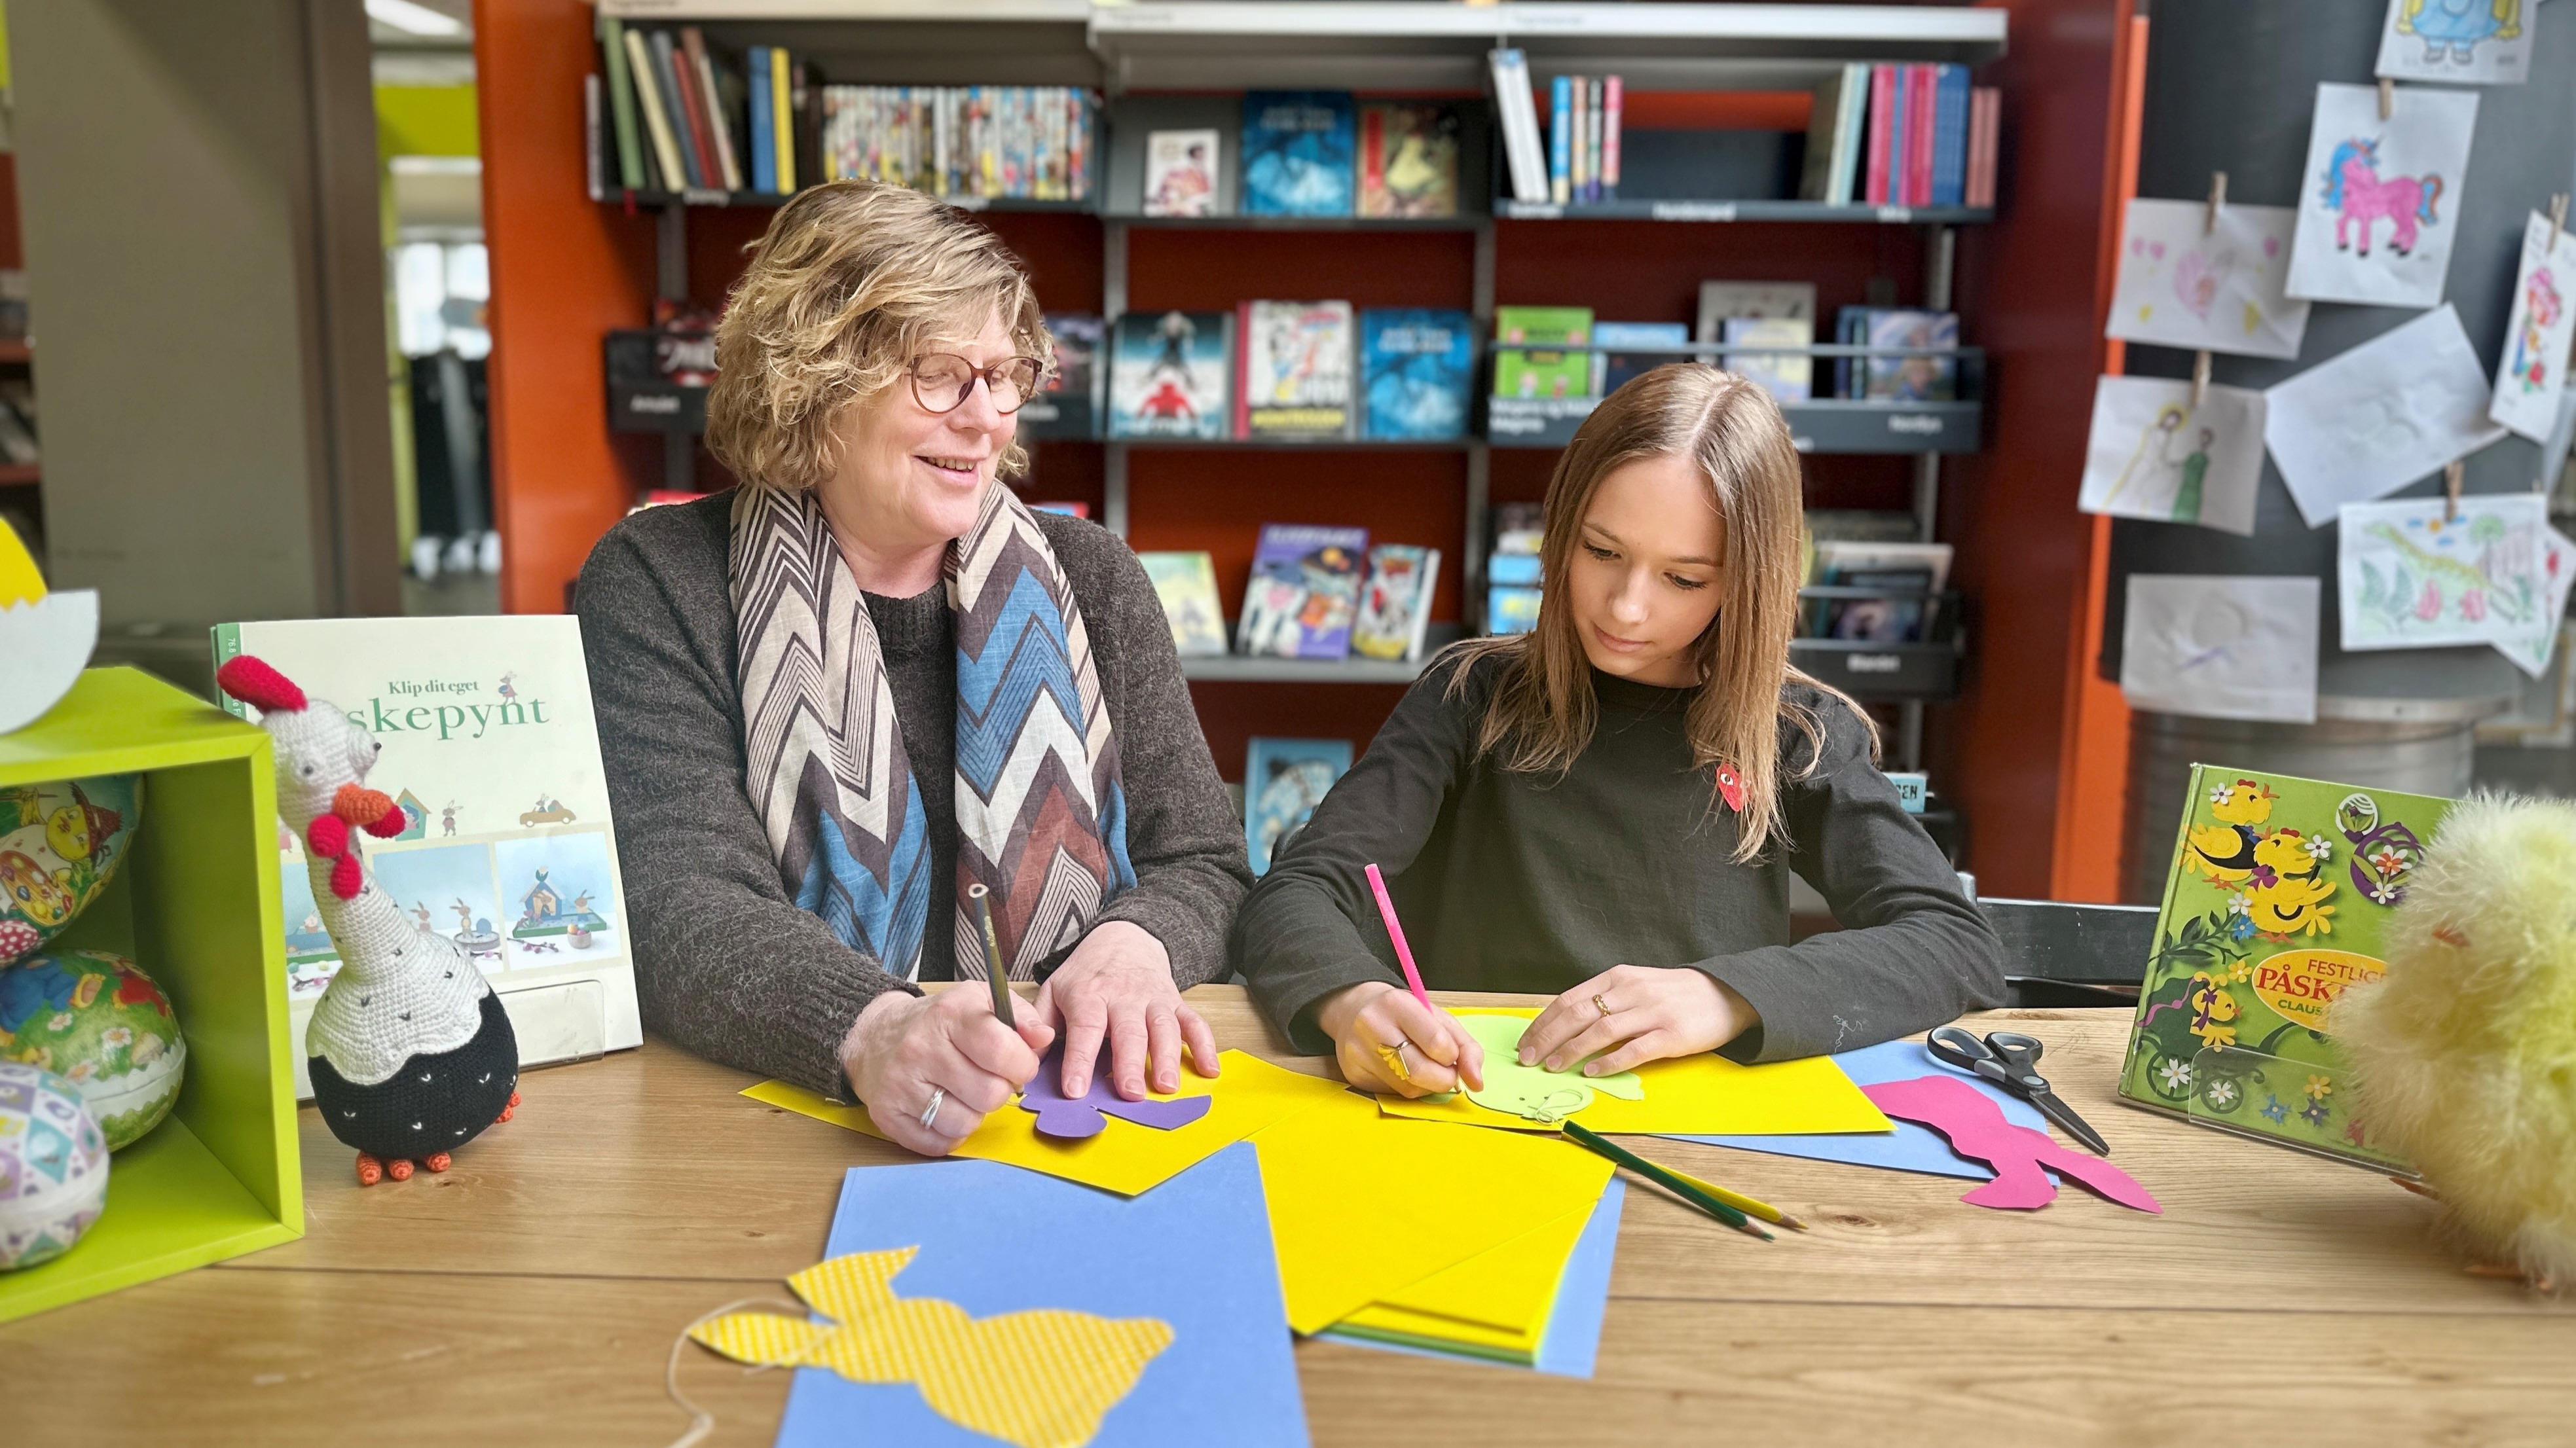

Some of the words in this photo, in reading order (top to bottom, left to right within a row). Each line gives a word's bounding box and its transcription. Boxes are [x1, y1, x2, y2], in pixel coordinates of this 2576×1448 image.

[388, 681, 422, 697] Klip
[424, 679, 447, 693] dit
[448, 680, 479, 695] eget
[346, 697, 550, 740] skepynt
